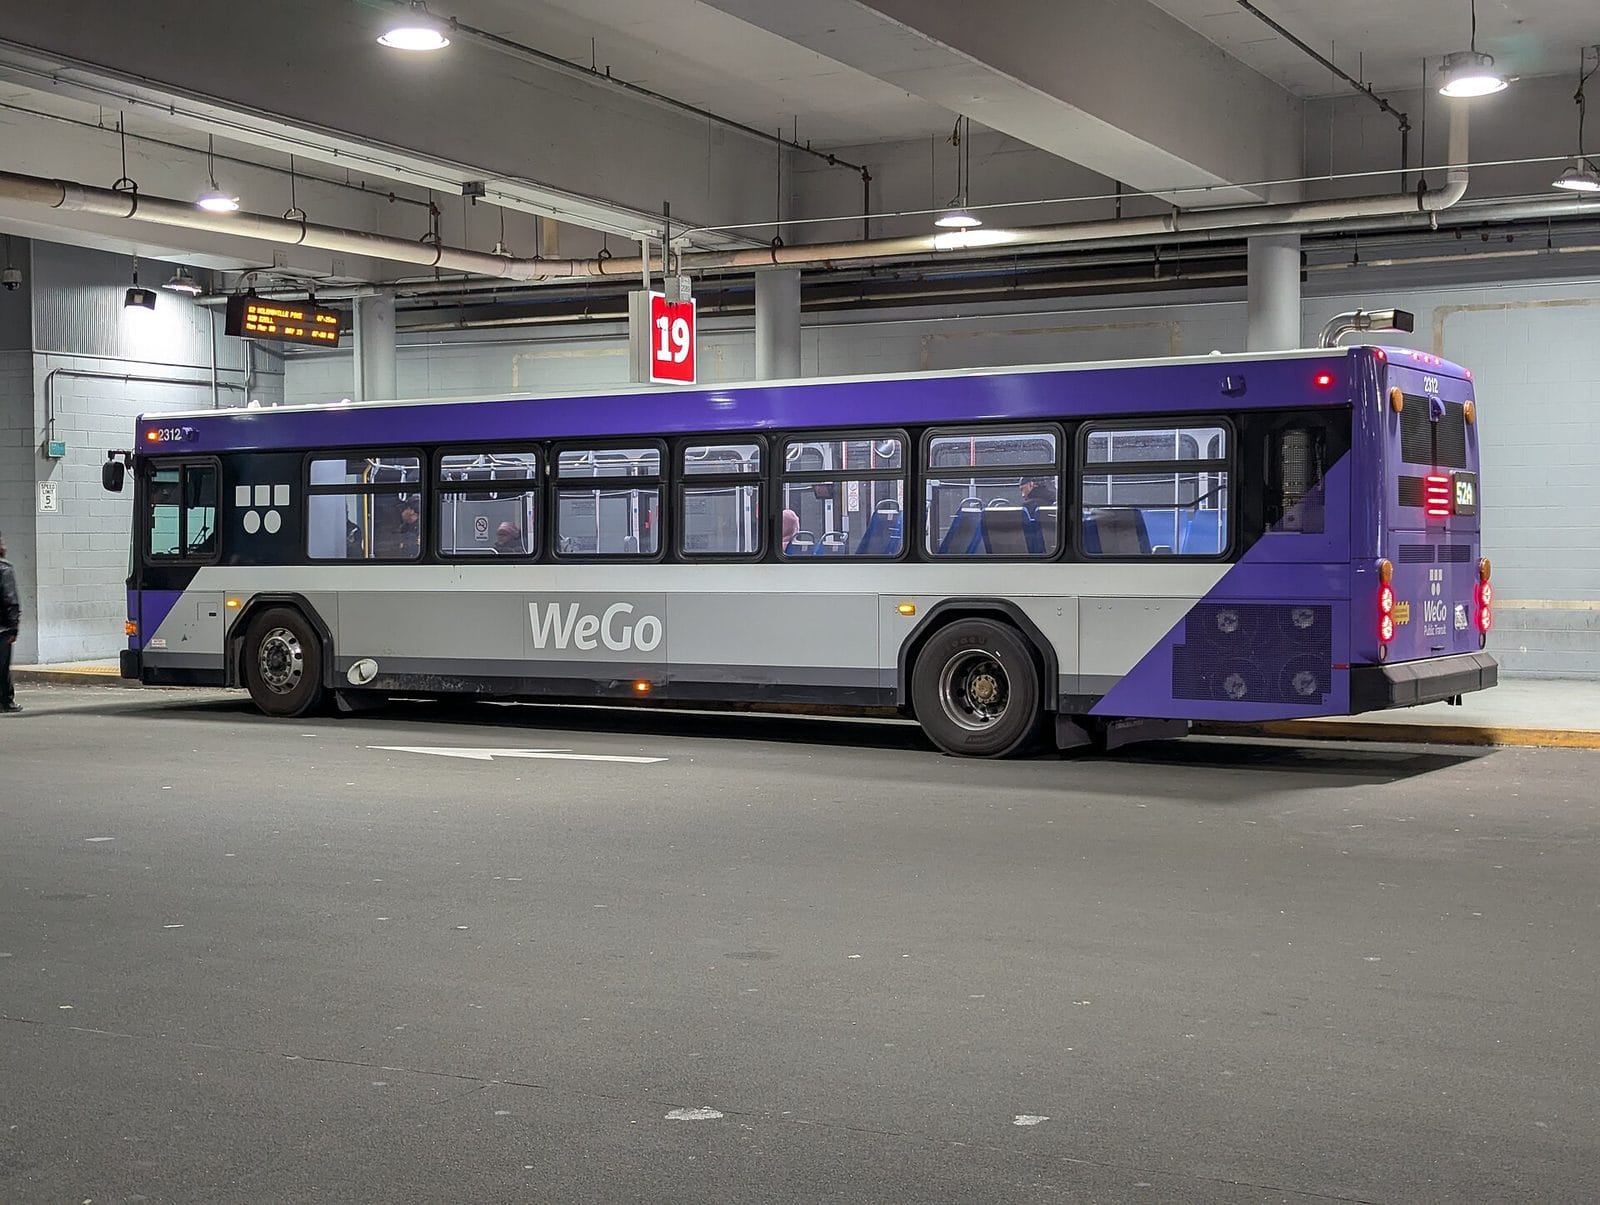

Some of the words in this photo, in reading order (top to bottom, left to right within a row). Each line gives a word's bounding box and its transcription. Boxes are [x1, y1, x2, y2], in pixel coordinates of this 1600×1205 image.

[656, 316, 690, 364] 19
[1424, 376, 1438, 394] 2312
[158, 428, 182, 441] 2312
[46, 495, 51, 505] 5
[1456, 481, 1473, 505] 52A
[1424, 600, 1447, 622] WeGo
[528, 602, 663, 652] WeGo
